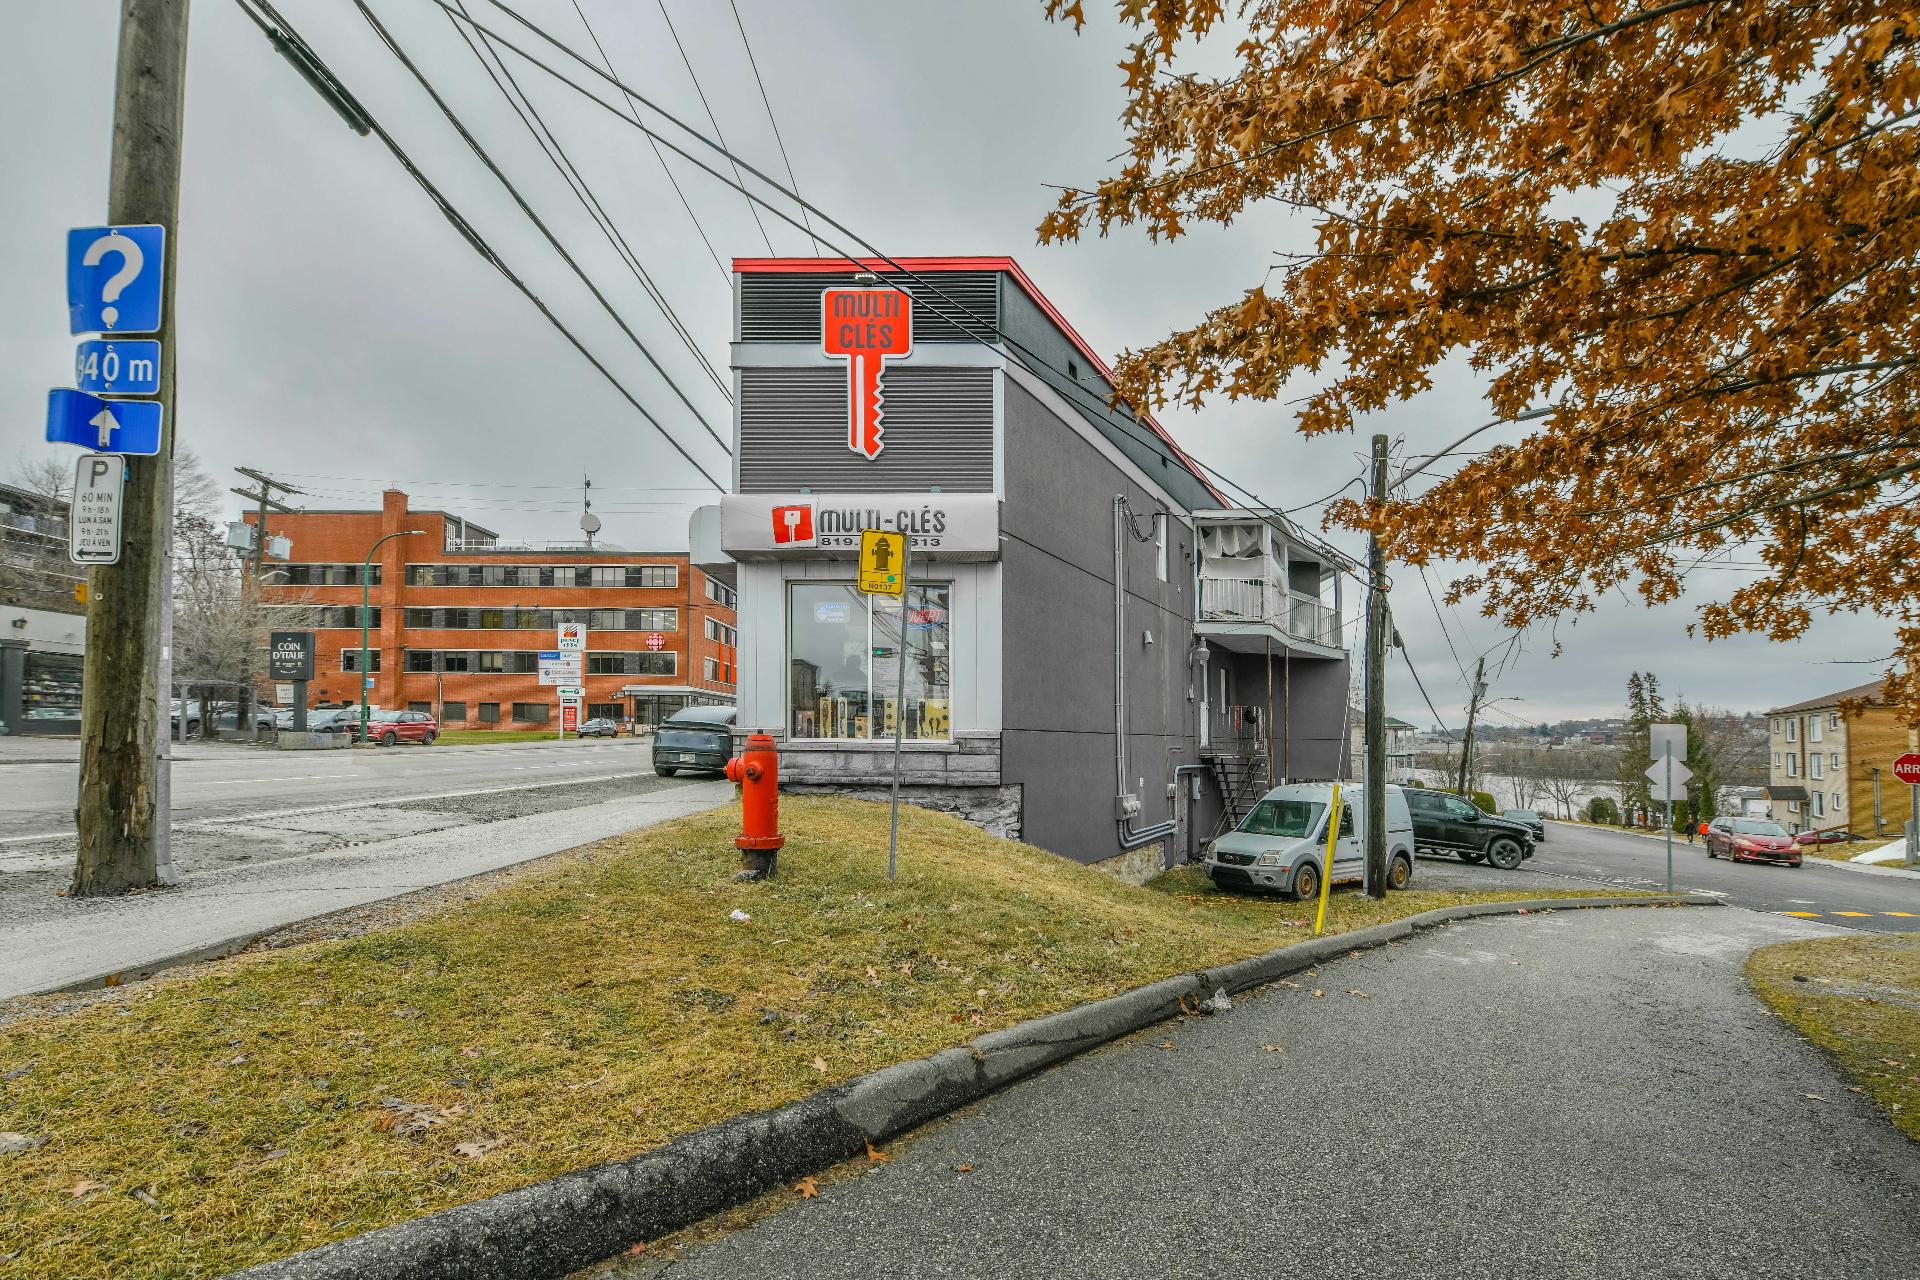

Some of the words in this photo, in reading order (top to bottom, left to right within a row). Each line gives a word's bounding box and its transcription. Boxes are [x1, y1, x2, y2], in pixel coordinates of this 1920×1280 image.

[834, 293, 899, 318] MULTI
[839, 318, 893, 349] CLÉS
[129, 359, 153, 382] m
[90, 461, 109, 488] P
[81, 492, 94, 503] 60
[96, 492, 113, 503] MIN
[78, 516, 92, 525] LUN
[98, 516, 112, 525] SAM
[819, 504, 946, 534] MULTI-CLÉS
[78, 538, 91, 547] JEU
[98, 538, 111, 547] VEN
[278, 642, 300, 651] COIN
